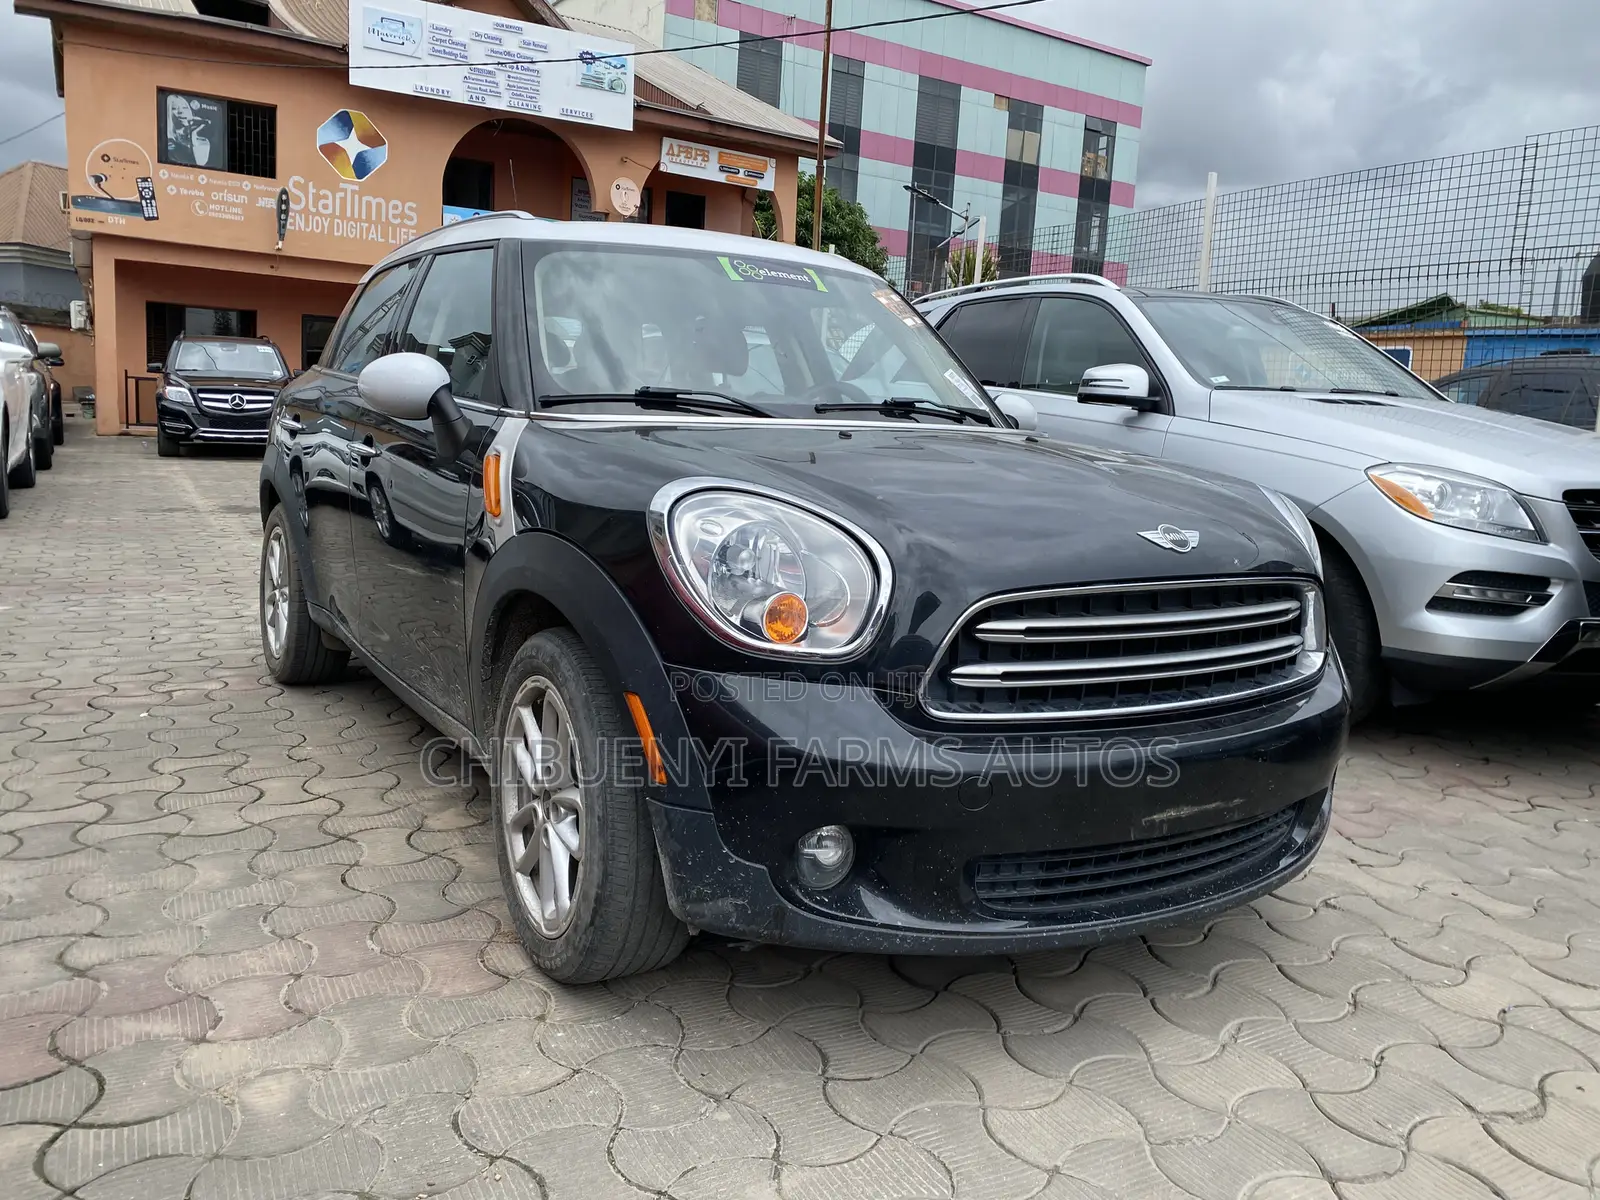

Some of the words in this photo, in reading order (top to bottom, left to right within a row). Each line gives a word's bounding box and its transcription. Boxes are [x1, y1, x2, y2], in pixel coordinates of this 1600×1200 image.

[432, 24, 452, 35] Laundry
[505, 24, 523, 32] SERVICES
[431, 36, 447, 44] Carpet
[448, 39, 467, 49] Cleaning
[484, 33, 502, 43] Cleaning
[533, 41, 548, 50] Removal
[520, 65, 540, 75] Delivery
[414, 84, 451, 95] LAUNDRY
[469, 94, 486, 102] AND
[508, 100, 542, 111] CLEANING
[561, 107, 593, 119] SERVICES
[288, 175, 418, 226] StarTimes
[209, 204, 243, 214] HOTLINE
[107, 215, 126, 225] DTH
[287, 211, 331, 235] ENJOY
[334, 218, 385, 243] DIGITAL
[388, 226, 417, 246] LIFE
[759, 268, 811, 283] element
